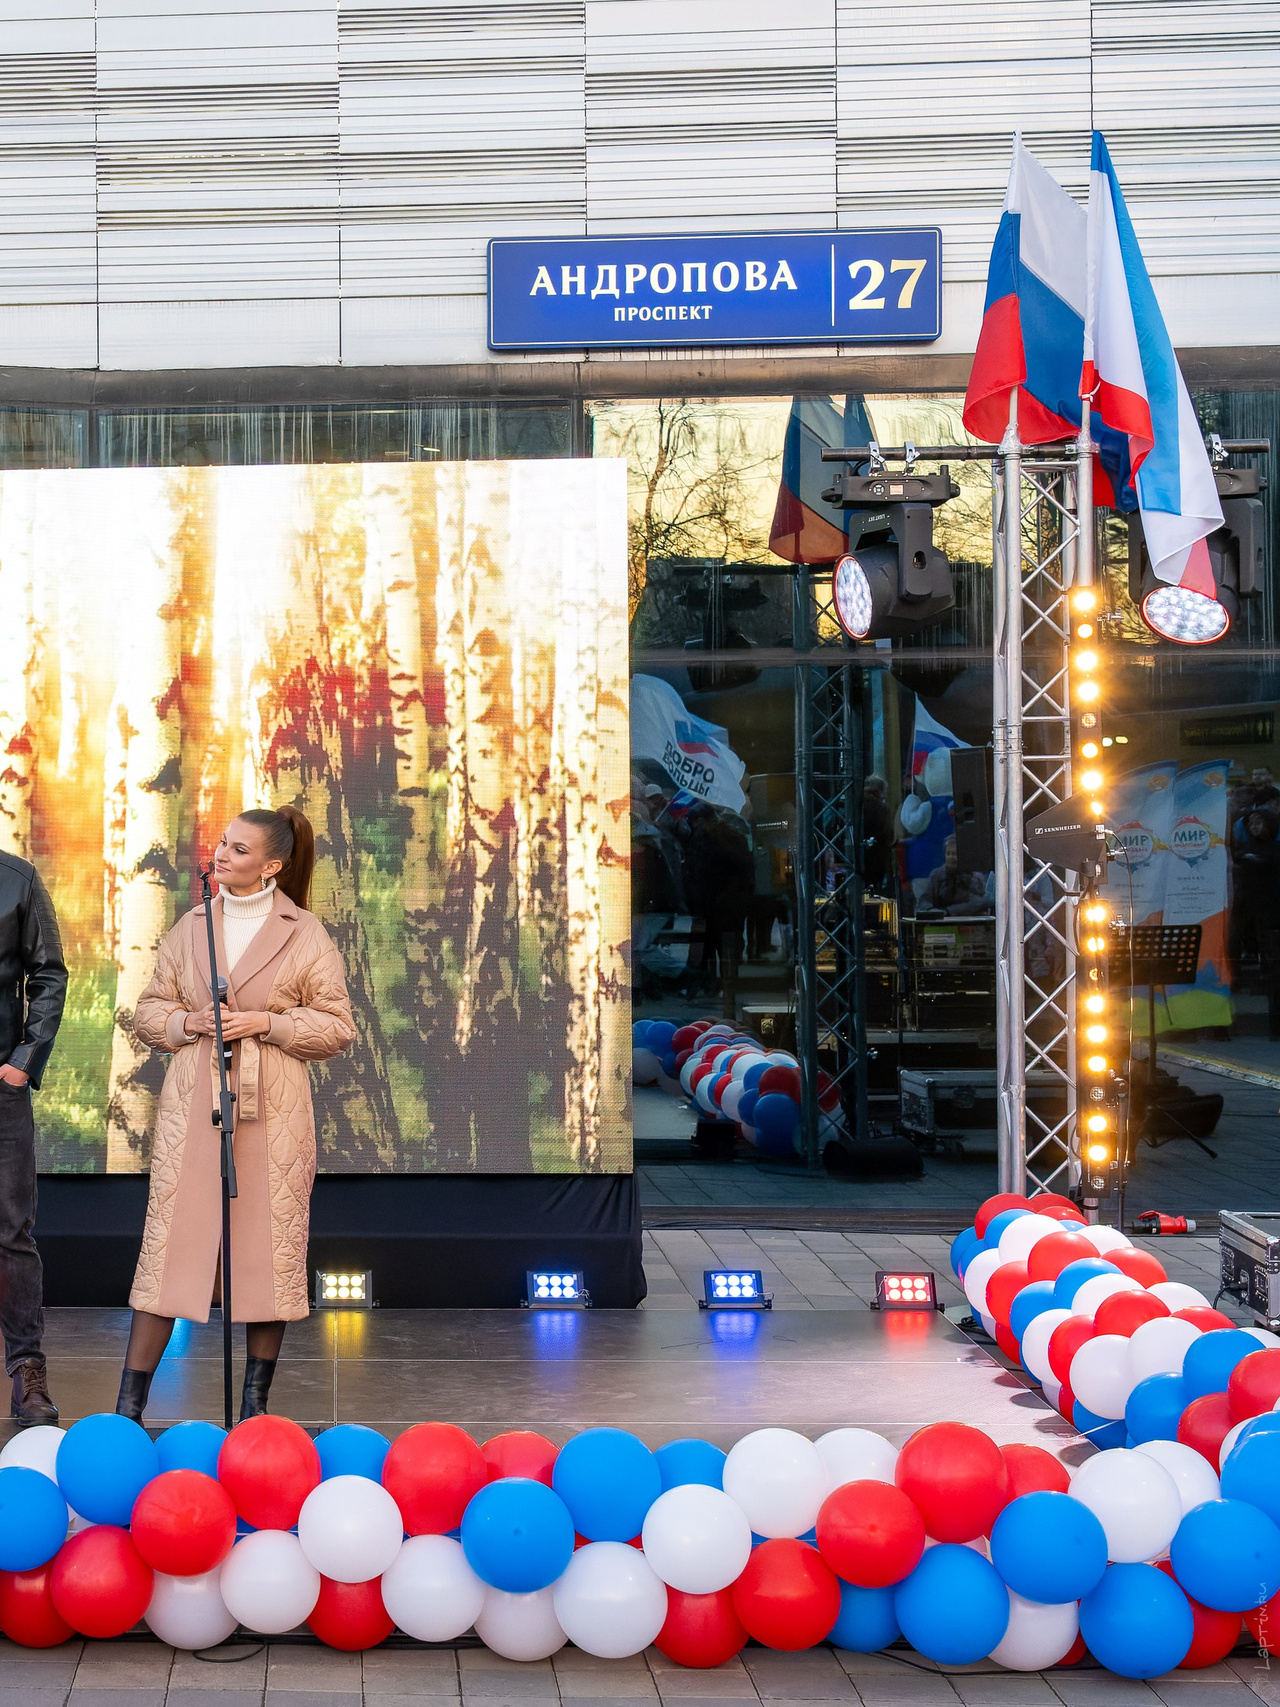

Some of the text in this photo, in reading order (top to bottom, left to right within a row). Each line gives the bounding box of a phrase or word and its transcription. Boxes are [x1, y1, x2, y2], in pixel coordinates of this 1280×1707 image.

[529, 260, 798, 300] АНДРОПОВА
[847, 258, 928, 311] 27
[613, 304, 713, 322] ПРОСПЕКТ
[1044, 824, 1082, 833] SENNHEISER
[1173, 829, 1207, 842] МИР
